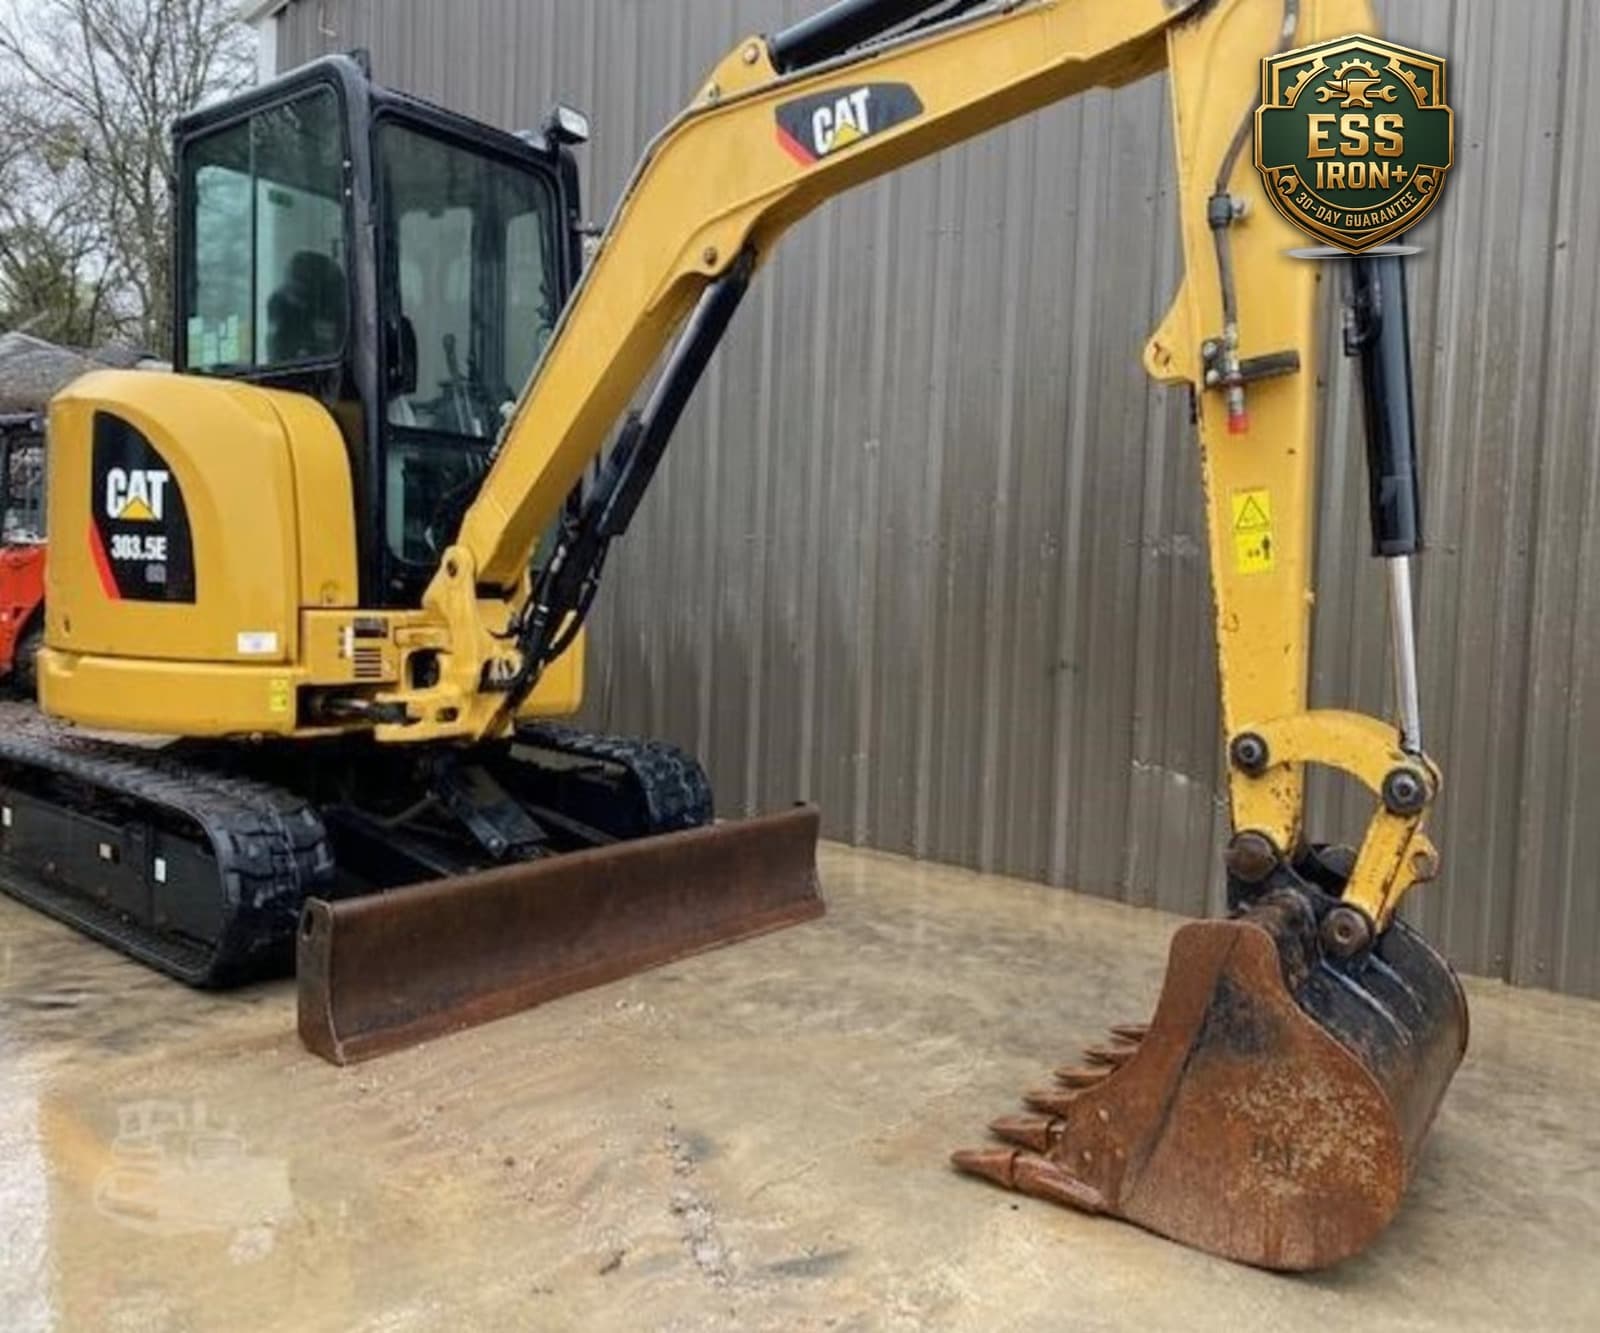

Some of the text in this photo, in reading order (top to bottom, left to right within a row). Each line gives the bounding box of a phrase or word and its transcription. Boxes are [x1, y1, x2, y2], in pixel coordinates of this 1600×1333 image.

[812, 86, 870, 155] CAT
[106, 467, 168, 520] CAT
[111, 535, 167, 561] 303.5E
